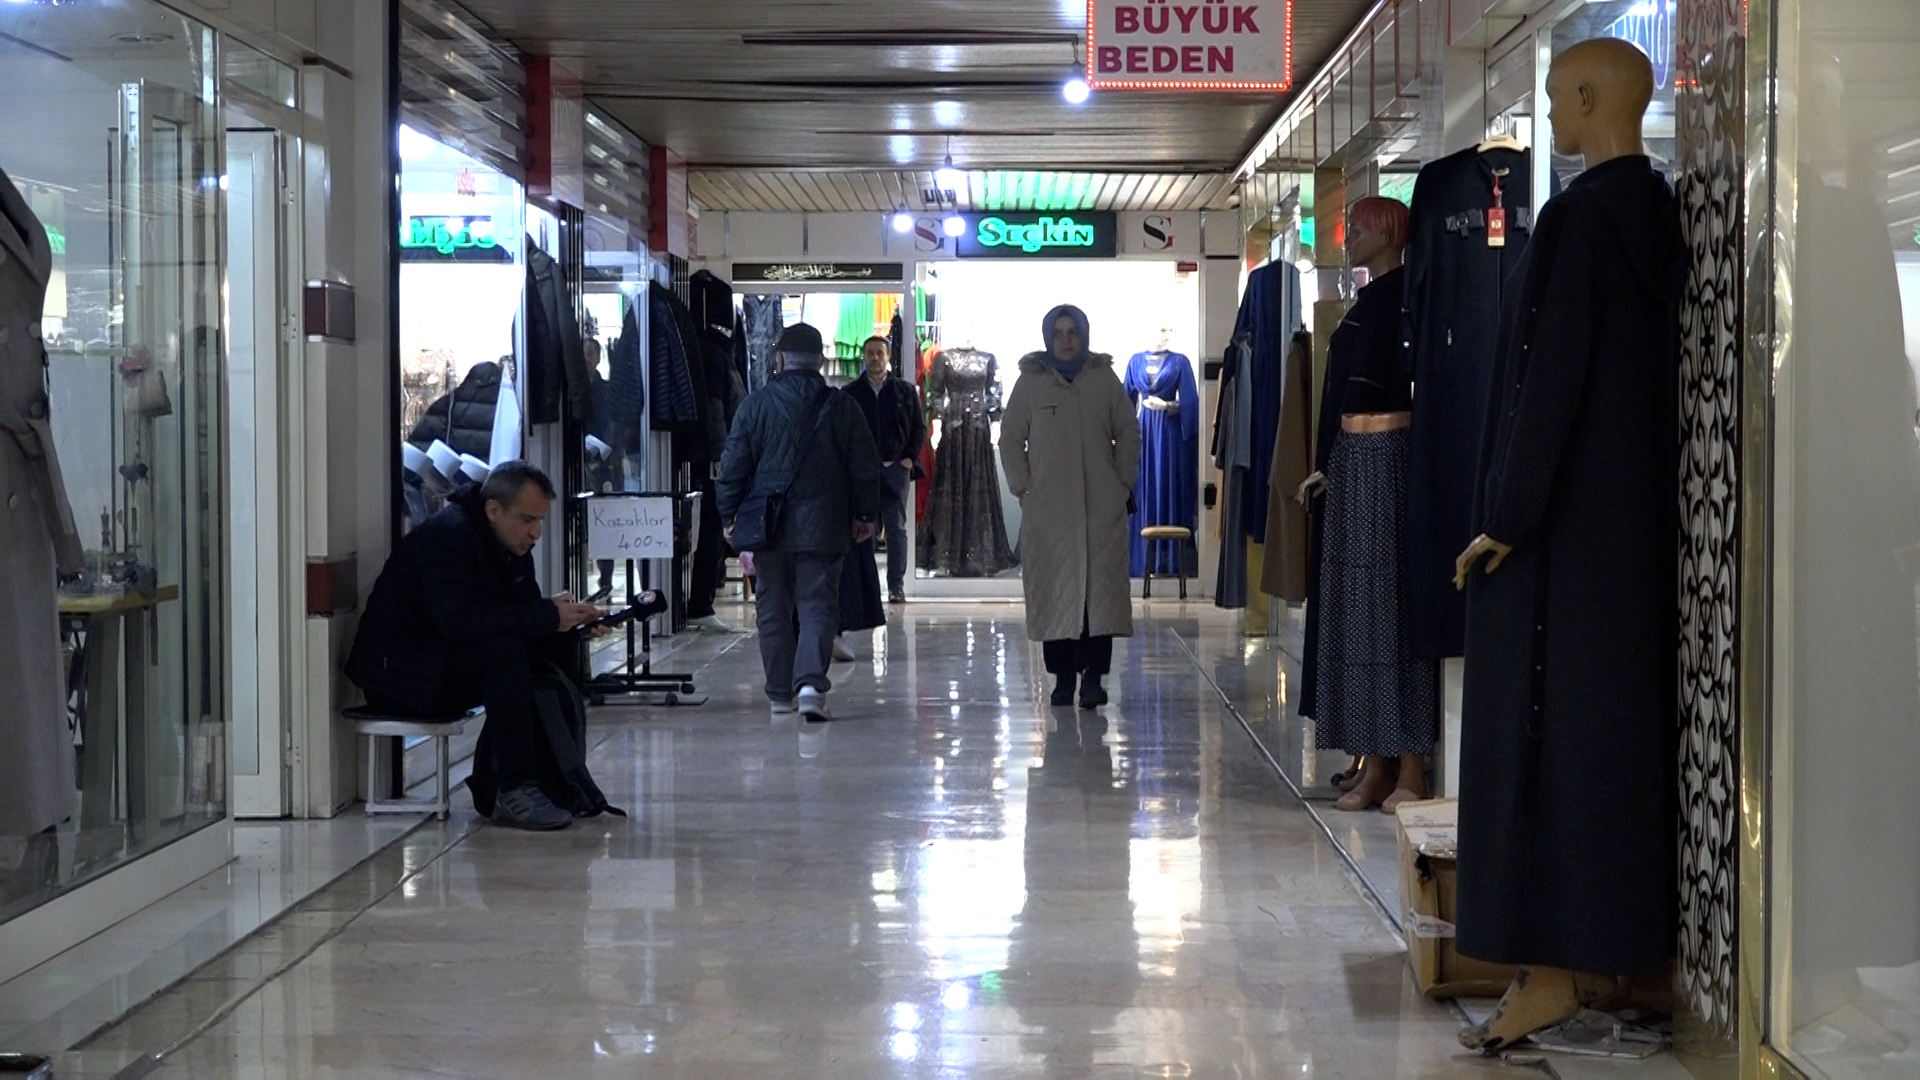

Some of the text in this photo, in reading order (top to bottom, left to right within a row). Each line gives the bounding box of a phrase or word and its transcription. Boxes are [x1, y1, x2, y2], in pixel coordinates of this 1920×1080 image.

[1115, 0, 1260, 34] BÜYÜK
[1098, 46, 1234, 74] BEDEN
[593, 508, 668, 528] Kazaklar
[618, 533, 652, 550] 400
